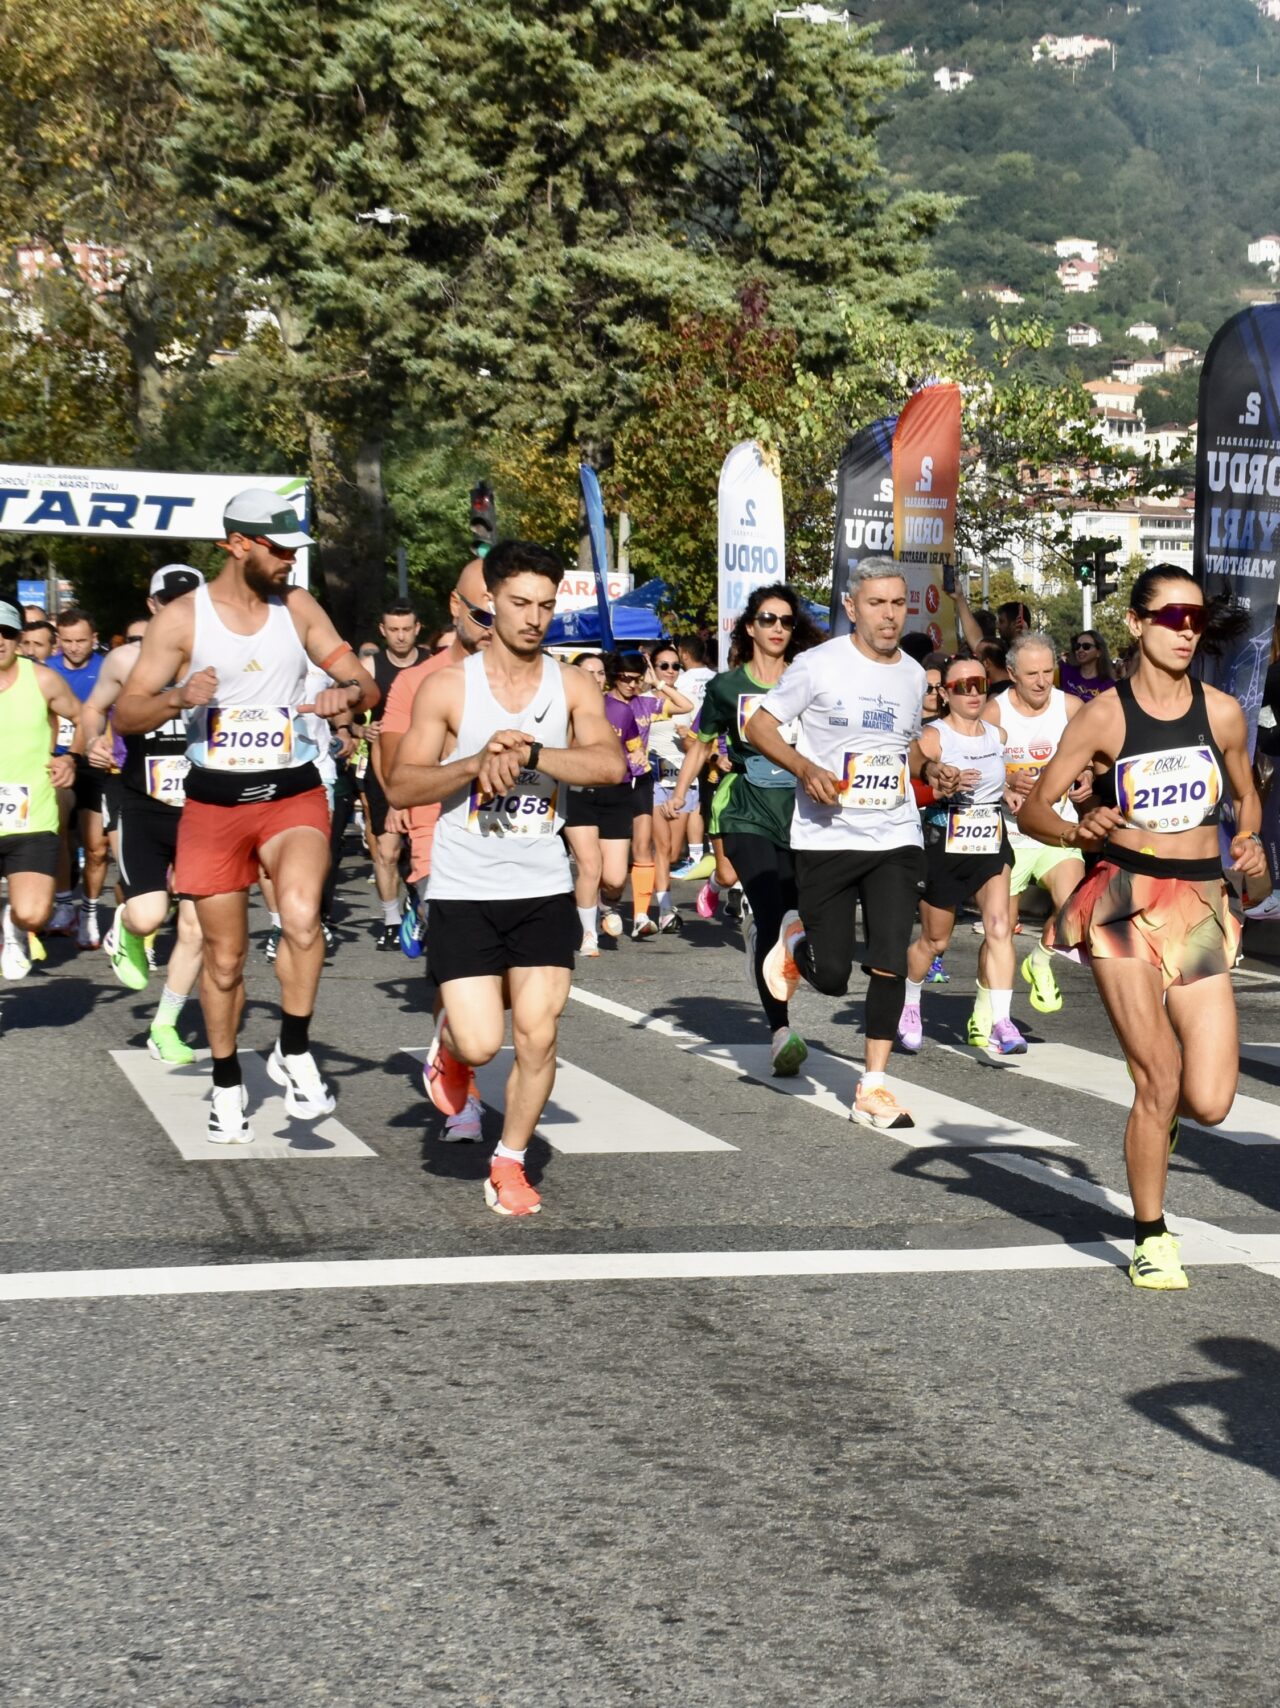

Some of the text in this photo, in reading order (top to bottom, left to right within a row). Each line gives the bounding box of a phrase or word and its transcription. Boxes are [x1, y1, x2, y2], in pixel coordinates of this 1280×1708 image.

[59, 480, 119, 491] MARATONU
[213, 731, 285, 748] 21080
[851, 774, 899, 790] 21143
[1132, 779, 1207, 810] 21210
[477, 794, 552, 815] 21058
[954, 825, 999, 839] 21027
